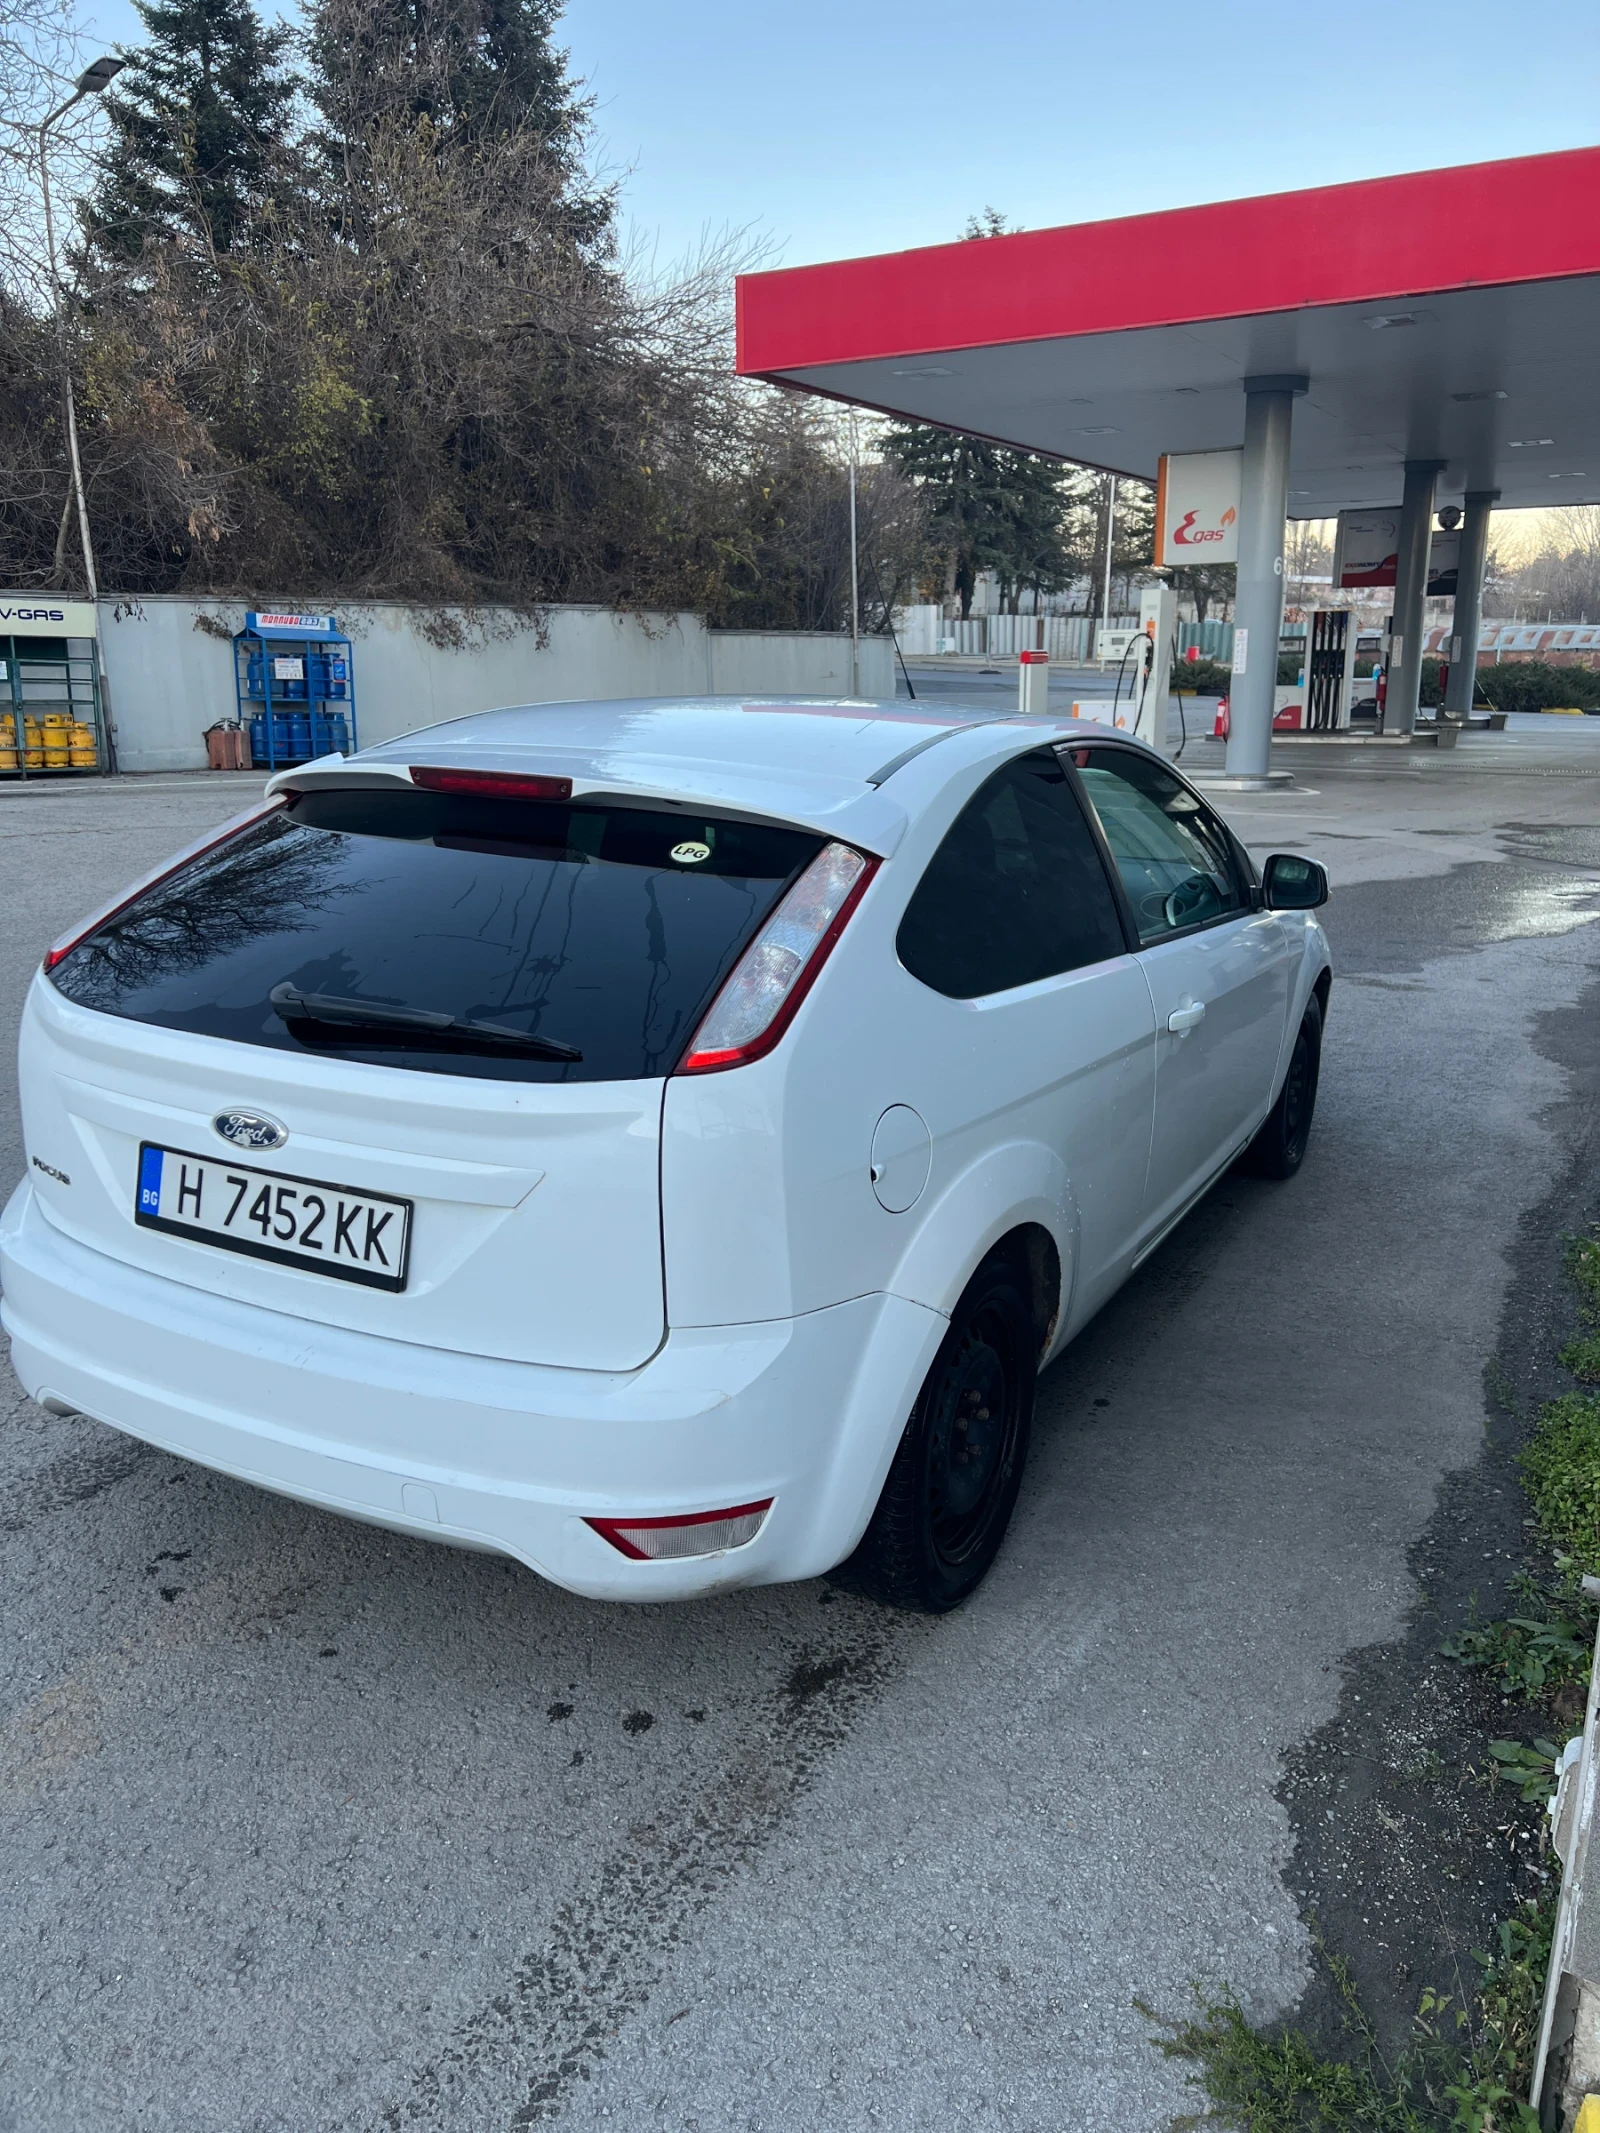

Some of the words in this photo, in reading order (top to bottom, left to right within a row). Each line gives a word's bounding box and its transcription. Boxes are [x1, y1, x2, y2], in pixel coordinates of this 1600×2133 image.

[1273, 556, 1282, 575] 6
[0, 608, 64, 621] V-GAS
[673, 845, 707, 859] LPG
[224, 1114, 267, 1142] Ford
[141, 1188, 159, 1206] BG
